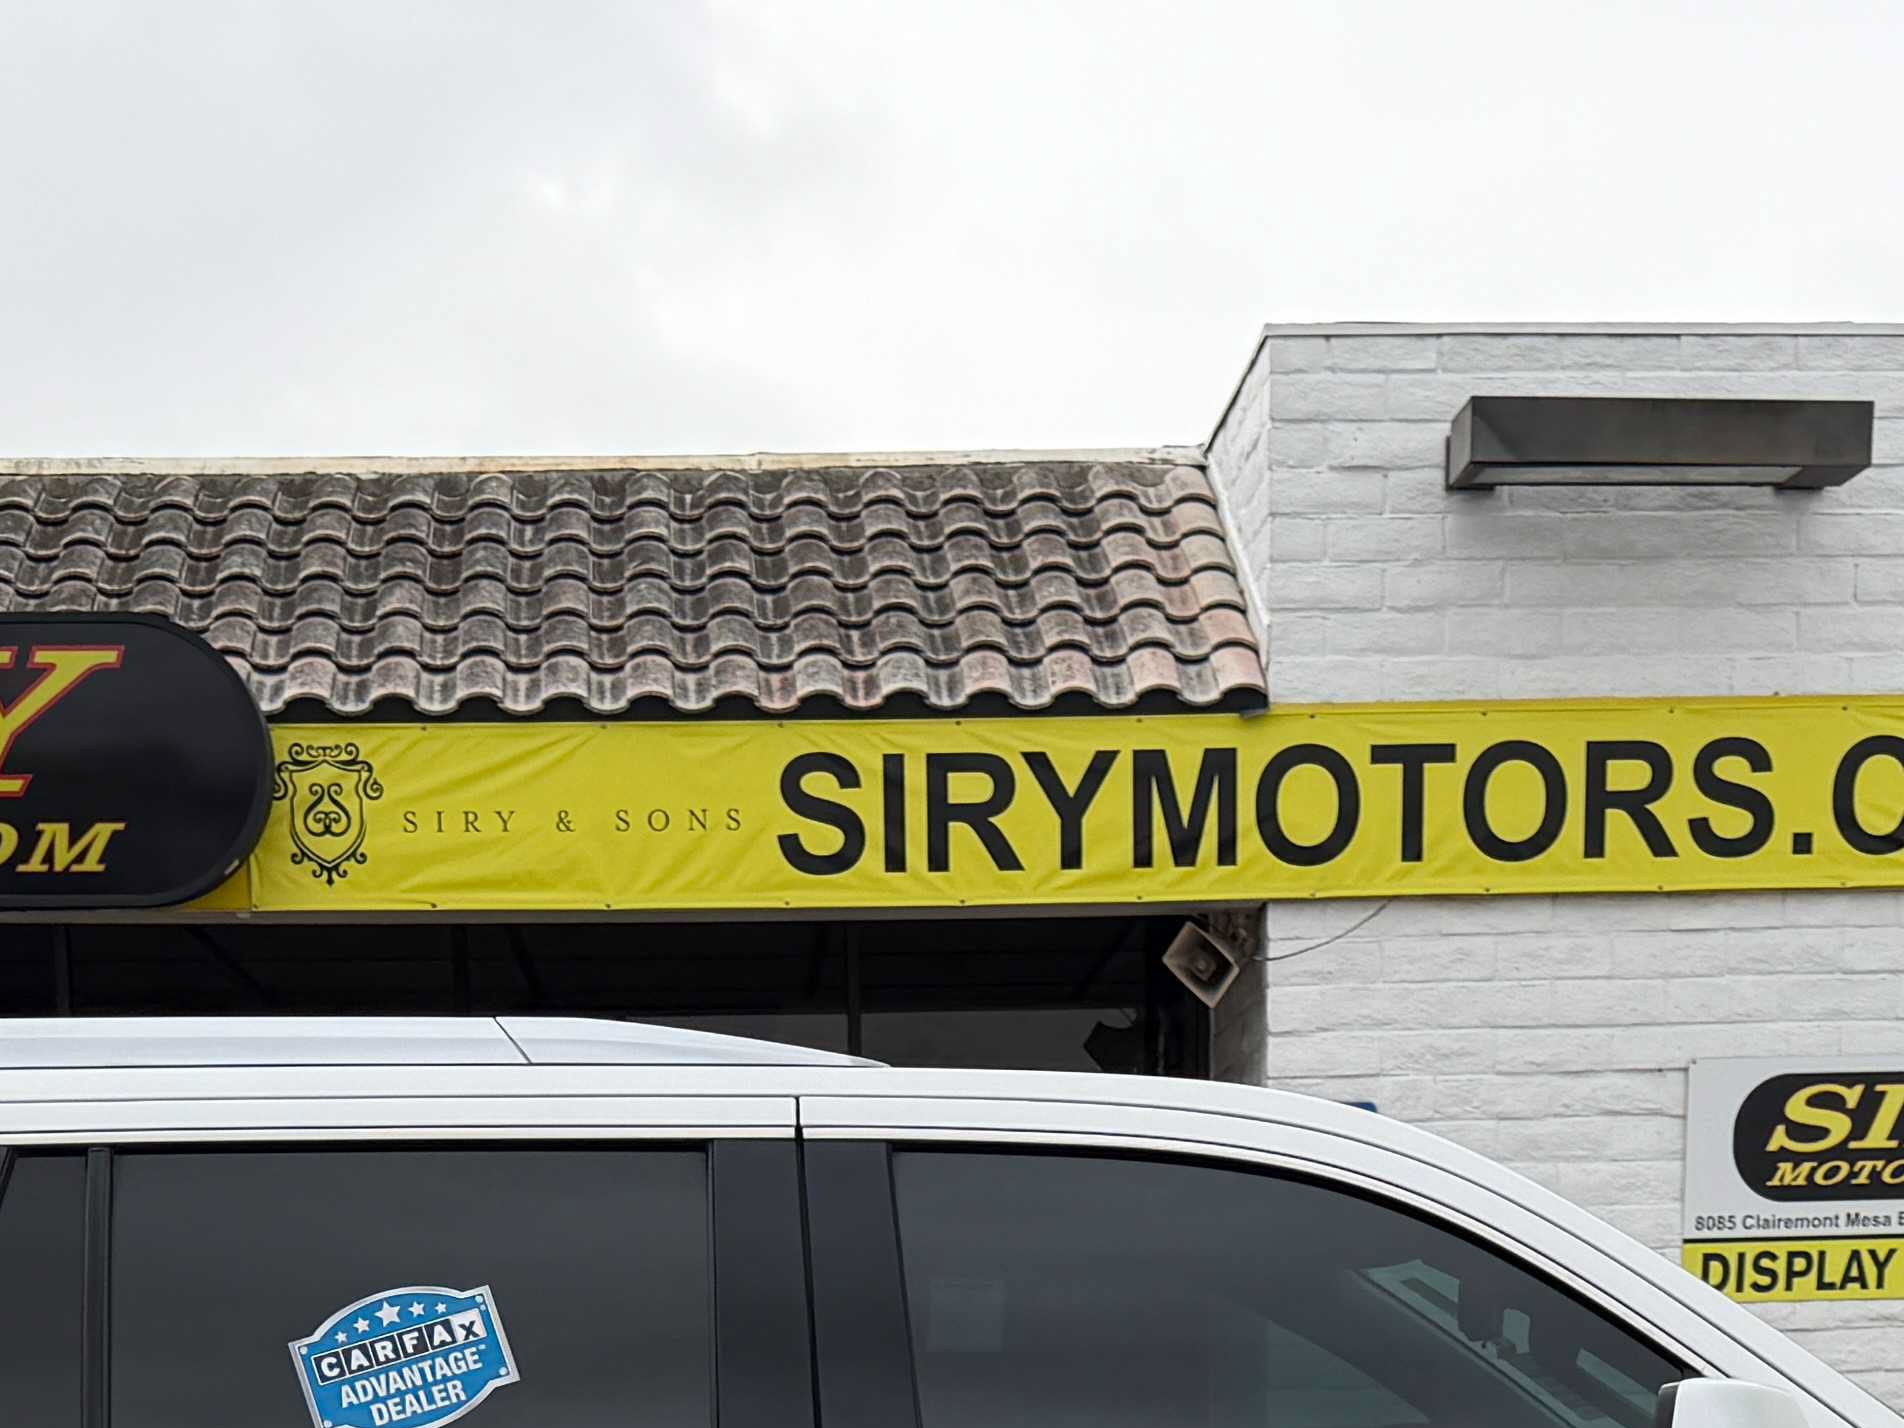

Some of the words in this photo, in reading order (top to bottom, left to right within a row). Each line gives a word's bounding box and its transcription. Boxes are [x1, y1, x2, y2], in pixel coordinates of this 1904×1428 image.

[402, 809, 516, 834] SIRY
[555, 809, 577, 833] &
[614, 808, 743, 832] SONS
[1694, 1214, 1738, 1231] 8085
[1742, 1211, 1841, 1230] Clairemont
[1845, 1210, 1894, 1228] Mesa
[1701, 1247, 1900, 1294] DISPLAY
[320, 1319, 480, 1379] CARFAX
[340, 1346, 484, 1409] ADVANTAGE
[369, 1379, 468, 1427] DEALER
